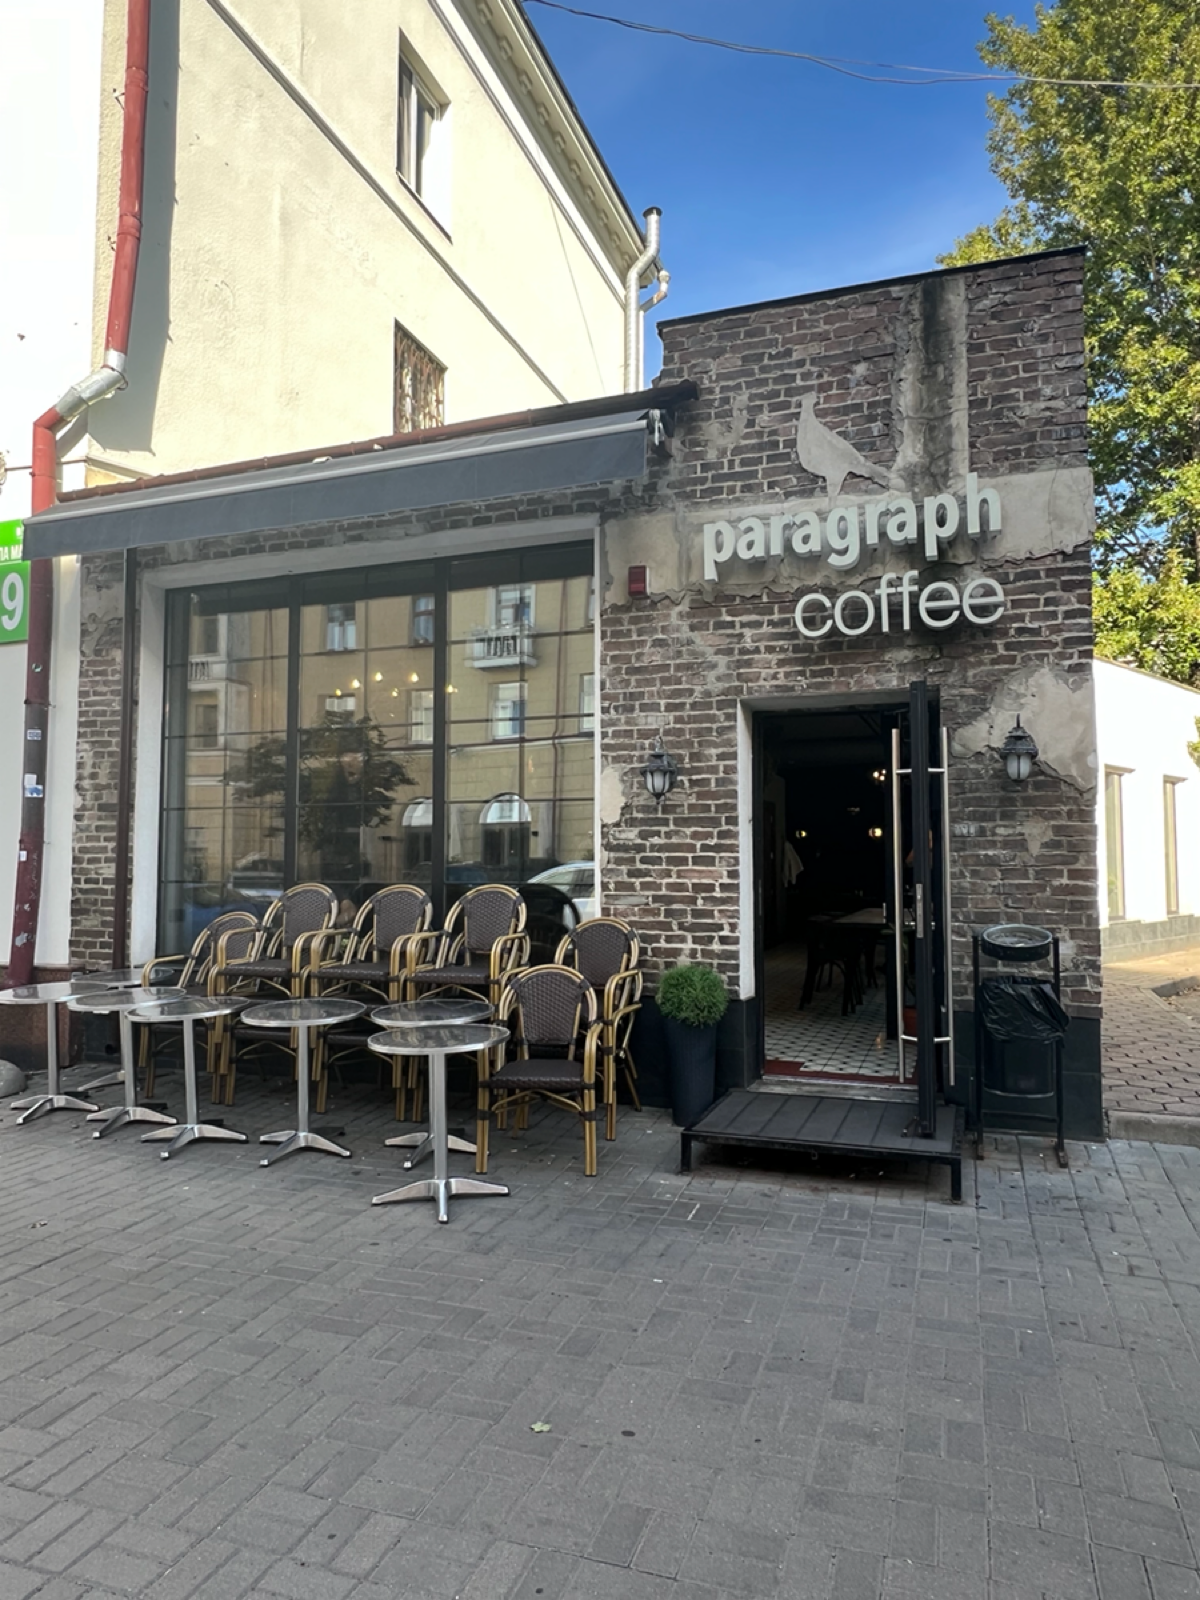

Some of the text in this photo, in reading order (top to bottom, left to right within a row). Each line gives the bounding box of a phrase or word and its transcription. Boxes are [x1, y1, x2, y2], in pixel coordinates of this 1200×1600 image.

[703, 472, 1002, 582] paragraph
[1, 572, 24, 631] 9
[794, 570, 1005, 638] coffee
